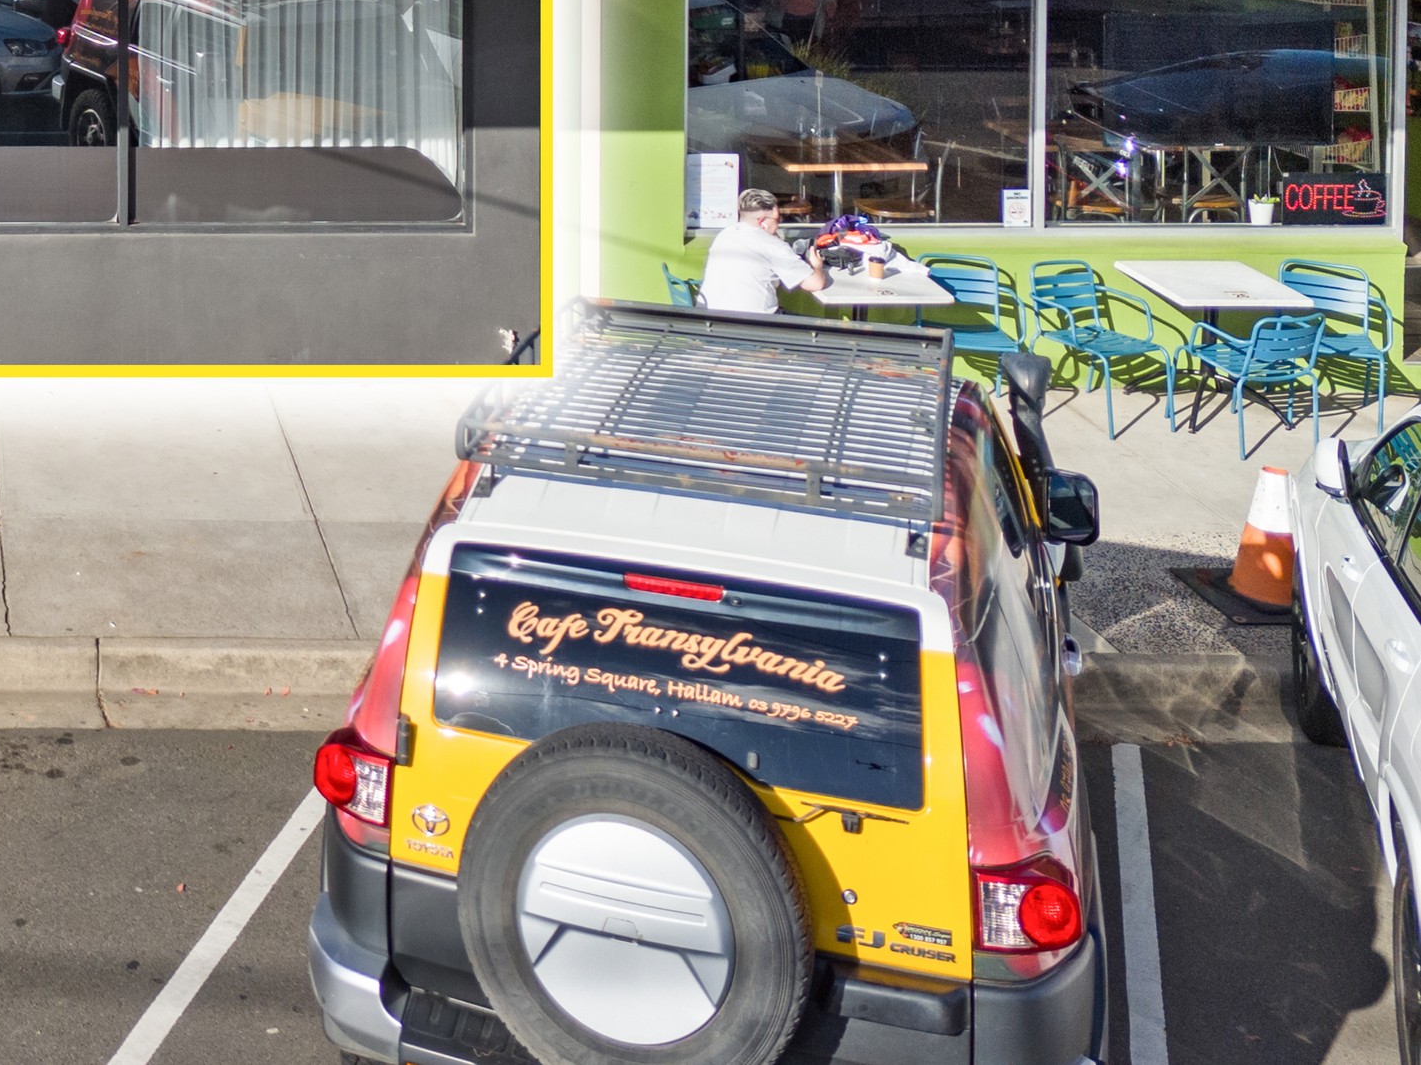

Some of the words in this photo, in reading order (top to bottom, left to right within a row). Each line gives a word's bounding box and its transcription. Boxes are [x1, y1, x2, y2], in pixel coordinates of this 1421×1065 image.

[1284, 184, 1355, 211] COFFEE
[507, 601, 589, 655] Cafe
[593, 607, 846, 693] Transylvania
[494, 653, 508, 669] 4
[512, 656, 580, 685] Spring
[584, 668, 661, 696] Square,
[667, 680, 743, 708] Hallam
[767, 701, 810, 722] 9796
[813, 709, 859, 730] 5227
[407, 838, 455, 860] TOYOTA
[836, 924, 885, 949] FJ
[889, 942, 956, 963] CRUISER
